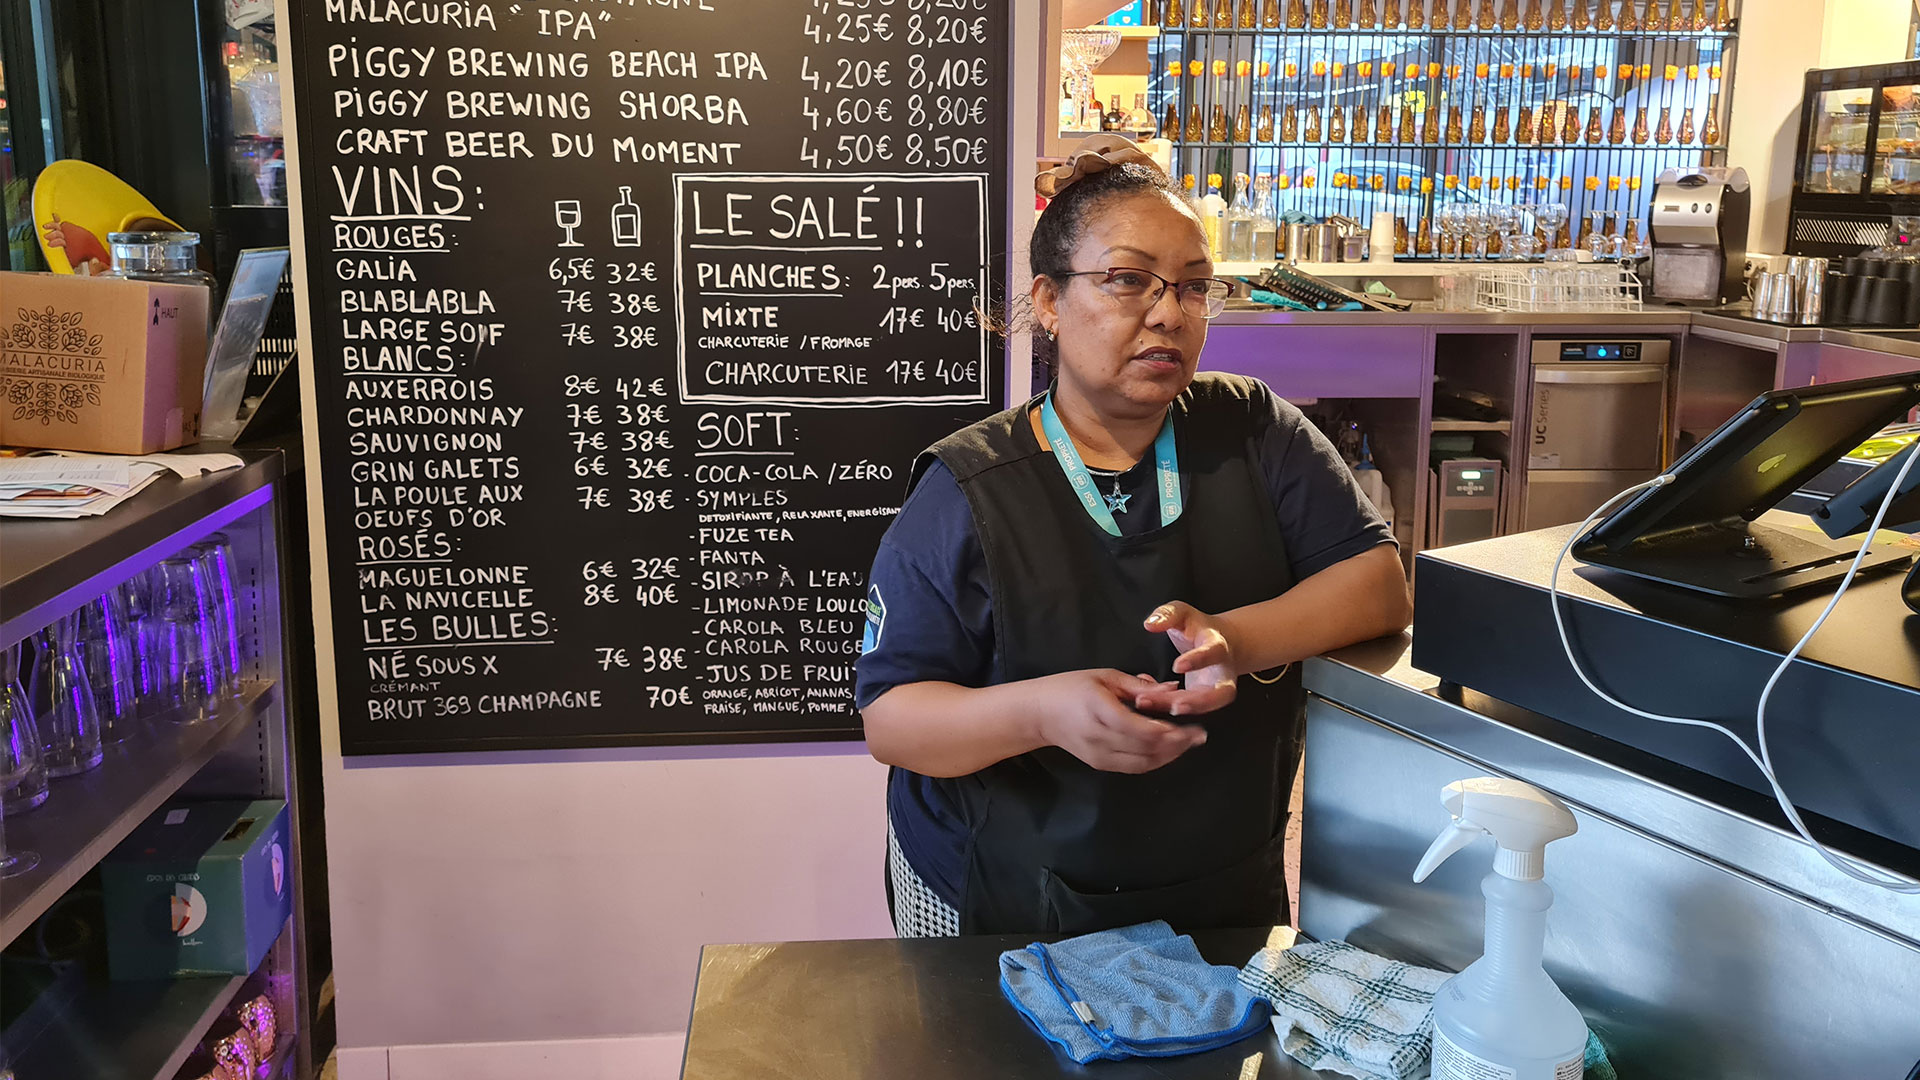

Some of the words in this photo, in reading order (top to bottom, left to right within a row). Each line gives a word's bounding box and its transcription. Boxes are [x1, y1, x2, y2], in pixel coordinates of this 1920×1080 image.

[804, 13, 893, 43] 4,25€
[907, 14, 987, 48] 8,20€
[448, 48, 588, 77] BREWING
[609, 51, 697, 78] BEACH
[715, 51, 767, 80] IPA
[801, 56, 891, 93] 4,20€
[908, 54, 988, 94] 8,10€
[447, 91, 590, 119] BREWING
[619, 91, 749, 126] SHORBA
[803, 97, 892, 131] 4,60€
[908, 94, 987, 131] 8,80€
[337, 128, 428, 155] CRAFT
[446, 131, 534, 158] BEER
[552, 133, 593, 157] DU
[800, 135, 893, 169] 4,50€
[905, 133, 987, 168] 8,50€
[693, 191, 753, 236] LE
[769, 184, 880, 240] SALÉ
[549, 258, 594, 285] 6,5€
[607, 262, 657, 284] 32€
[341, 289, 495, 314] BLABLABLA
[558, 290, 593, 312] 7€
[609, 293, 660, 316] 38€
[343, 318, 429, 341] LARGE
[561, 323, 594, 346] 7€
[613, 326, 658, 348] 38€
[879, 307, 924, 334] 17€
[938, 307, 977, 332] 40€
[886, 360, 925, 384] 17€
[936, 359, 976, 384] 40€
[346, 378, 493, 401] AUXERROIS
[565, 375, 600, 396] 8€
[616, 378, 667, 400] 42€
[348, 406, 523, 427] CHARDONNAY
[567, 404, 602, 427] 7€
[616, 404, 669, 426] 38€
[1538, 389, 1550, 424] Series
[350, 433, 501, 455] SAUVIGNON
[569, 432, 608, 453] 7€
[622, 430, 674, 451] 38€
[1535, 425, 1547, 445] UC
[1054, 437, 1077, 471] PROPRETÉ
[352, 461, 413, 482] GRIN
[425, 457, 519, 479] GALETS
[575, 455, 608, 476] 6€
[626, 458, 672, 479] 32€
[696, 464, 818, 483] COCA-COLA
[1161, 459, 1174, 498] PROPRETÉ
[355, 487, 386, 507] LA
[395, 487, 467, 505] POULE
[479, 485, 522, 503] AUX
[577, 486, 610, 509] 7€
[628, 489, 674, 512] 38€
[697, 490, 787, 510] SYMPLES
[355, 509, 432, 529] OEUFS
[450, 507, 505, 527] D'OR
[699, 528, 749, 544] FUZE
[755, 529, 793, 541] TEA
[700, 550, 764, 566] FANTA
[360, 566, 528, 589] MAGUELONNE
[583, 561, 617, 580] 6€
[632, 557, 680, 579] 32€
[778, 564, 795, 589] À
[362, 595, 395, 613] LA
[406, 589, 533, 610] NAVICELLE
[584, 584, 619, 605] 8€
[637, 584, 678, 606] 40€
[704, 597, 808, 613] LIMONADE
[364, 618, 416, 643] LES
[705, 619, 784, 635] CAROLA
[800, 619, 853, 633] BLEU
[706, 638, 788, 656] CAROLA
[369, 650, 409, 679] NÉ
[595, 648, 630, 670] 7€
[643, 646, 687, 672] 38€
[707, 665, 751, 683] JUS
[760, 664, 792, 681] DE
[370, 680, 440, 693] CRÉMANT
[368, 698, 426, 720] BRUT
[434, 696, 471, 715] 369
[479, 691, 601, 713] CHAMPAGNE
[646, 686, 693, 708] 70€
